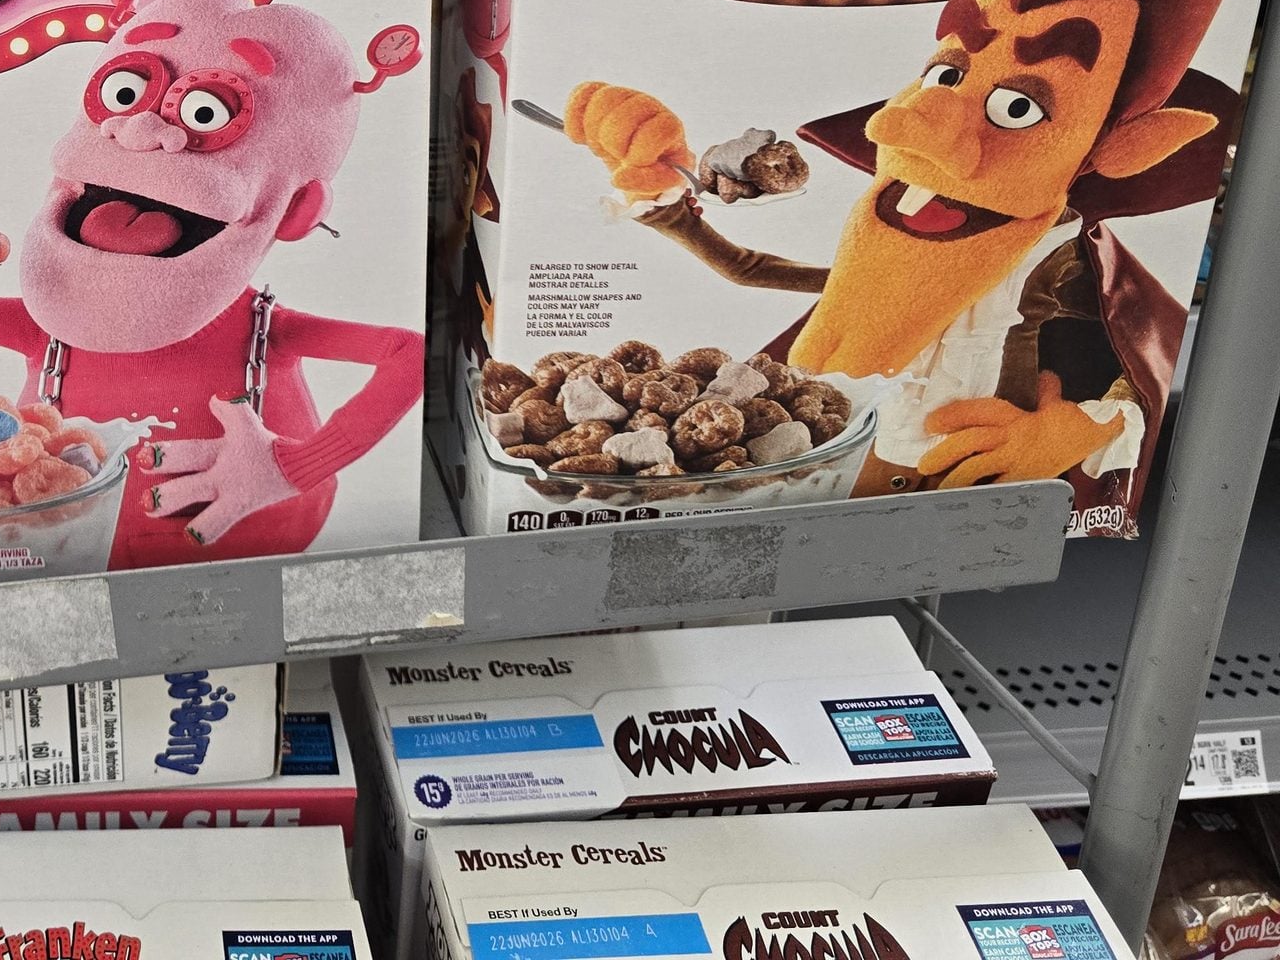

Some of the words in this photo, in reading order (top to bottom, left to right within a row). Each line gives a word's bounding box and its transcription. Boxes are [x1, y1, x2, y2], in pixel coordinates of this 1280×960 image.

[530, 263, 572, 271] ENLARGED
[573, 263, 584, 271] TO
[586, 263, 609, 271] SHOW
[611, 263, 639, 271] DETAIL
[528, 294, 591, 302] MARSHMALLOW
[592, 294, 624, 302] SHAPES
[625, 294, 642, 302] AND
[511, 514, 541, 531] 140
[1084, 507, 1124, 531] (532g)
[386, 661, 482, 686] Monster
[488, 657, 572, 679] Cereals
[648, 707, 717, 726] COUNT
[413, 729, 481, 747] 22JUN2026
[614, 708, 793, 778] CHOCULA
[455, 844, 564, 872] Monster
[570, 841, 666, 866] Cereals
[488, 908, 519, 920] BEST
[521, 907, 531, 918] If
[532, 906, 562, 918] Used
[563, 905, 578, 917] By
[761, 910, 840, 929] COUNT
[973, 904, 1032, 918] DOWNLOAD
[1033, 905, 1054, 915] THE
[1056, 904, 1074, 914] APP
[237, 934, 295, 944] DOWNLOAD
[298, 934, 316, 944] THE
[320, 934, 338, 943] APP
[490, 930, 565, 951] 22JUN2026
[974, 926, 1019, 940] SCAN
[1020, 929, 1051, 944] BOX
[1221, 923, 1261, 952] Sara
[1030, 940, 1060, 952] TOPS
